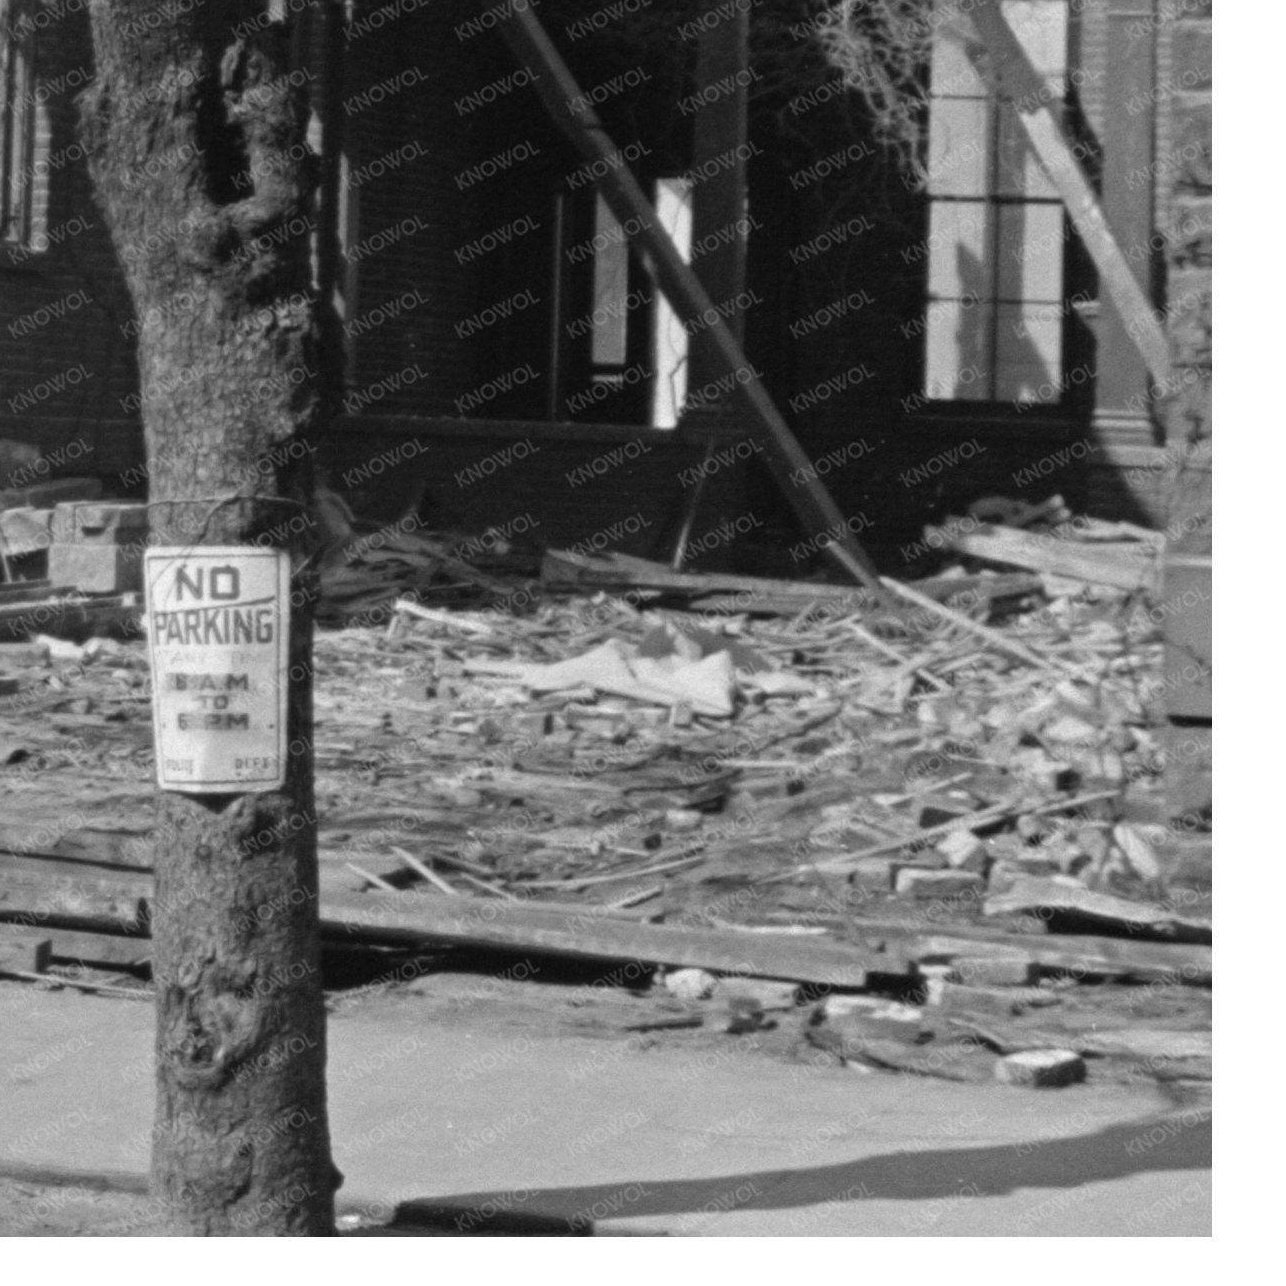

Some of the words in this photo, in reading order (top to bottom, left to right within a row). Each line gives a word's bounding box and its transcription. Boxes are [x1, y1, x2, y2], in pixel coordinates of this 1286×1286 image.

[177, 565, 239, 600] NO
[155, 610, 273, 645] PARKING
[198, 695, 228, 710] TO
